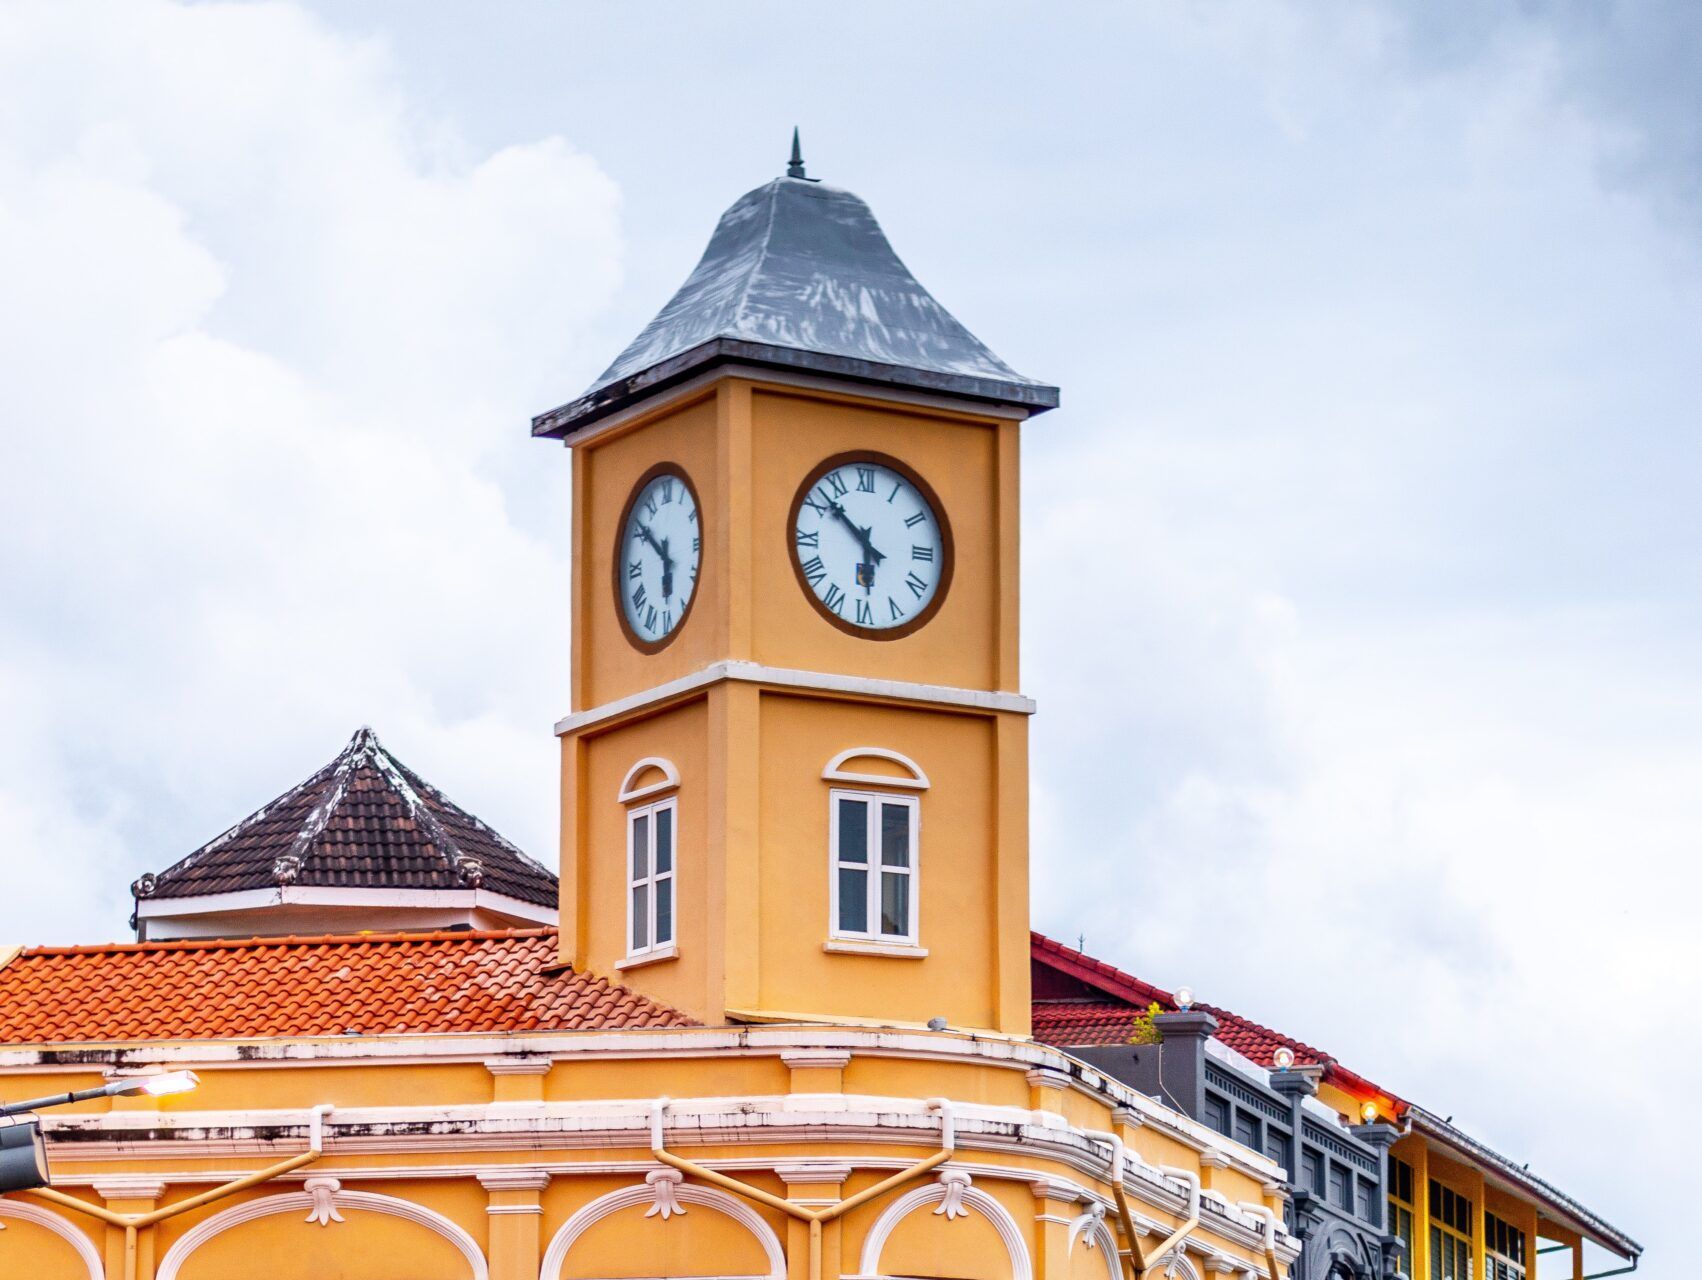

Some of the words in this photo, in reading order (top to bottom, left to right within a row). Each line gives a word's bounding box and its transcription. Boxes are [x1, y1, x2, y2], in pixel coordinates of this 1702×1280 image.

[823, 470, 850, 499] XI
[855, 467, 876, 494] XII
[802, 494, 828, 519] X
[903, 509, 926, 530] II
[796, 529, 819, 550] IX
[911, 544, 934, 564] III
[803, 555, 828, 588] VIII
[904, 570, 928, 601] IV
[823, 582, 846, 617] VII
[855, 598, 874, 626] VI
[888, 595, 905, 621] V
